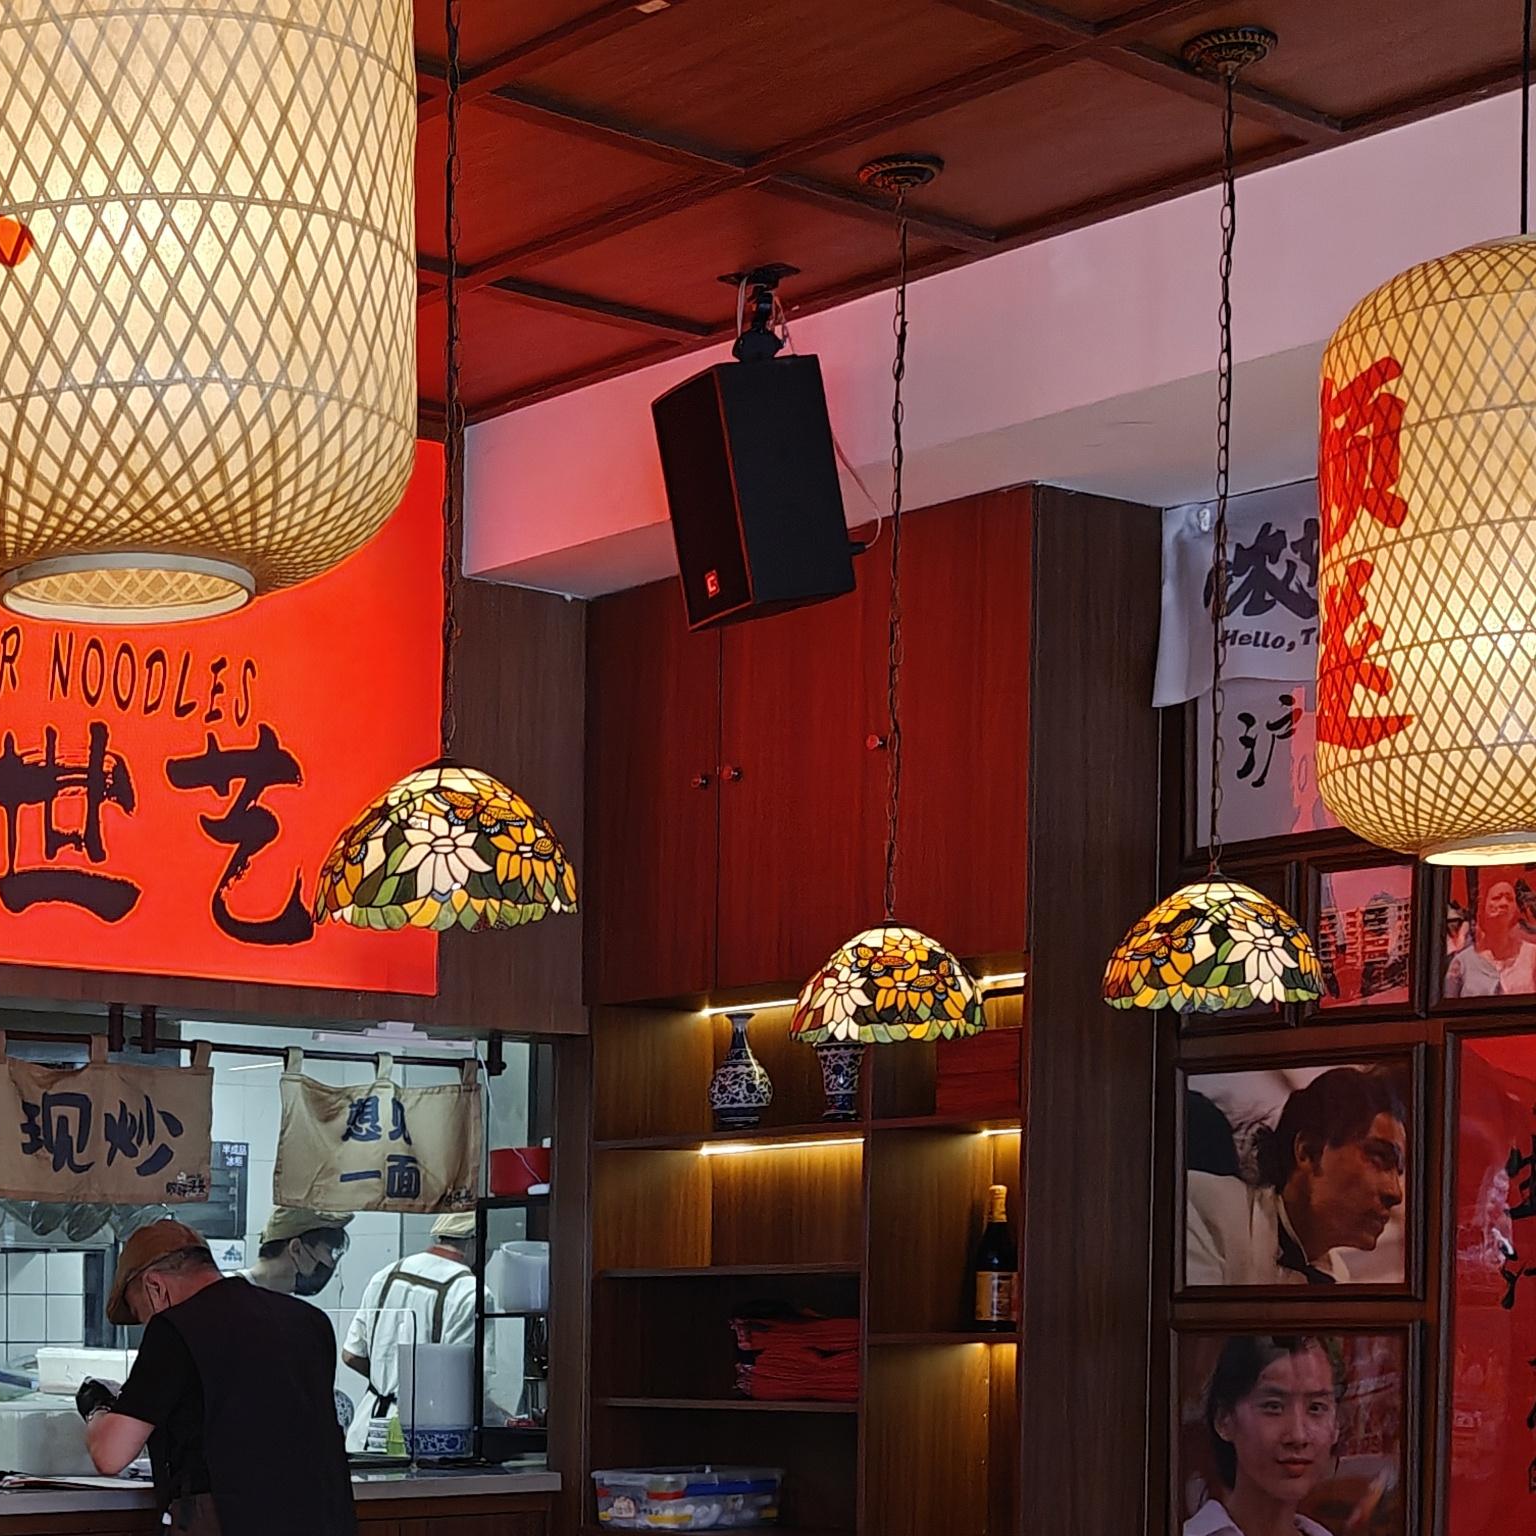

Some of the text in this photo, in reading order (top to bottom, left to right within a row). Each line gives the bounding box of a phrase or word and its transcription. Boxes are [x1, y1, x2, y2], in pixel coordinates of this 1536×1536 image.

[49, 631, 257, 727] NOODLES
[22, 1092, 184, 1177] 现炒
[339, 1154, 421, 1199] 一面
